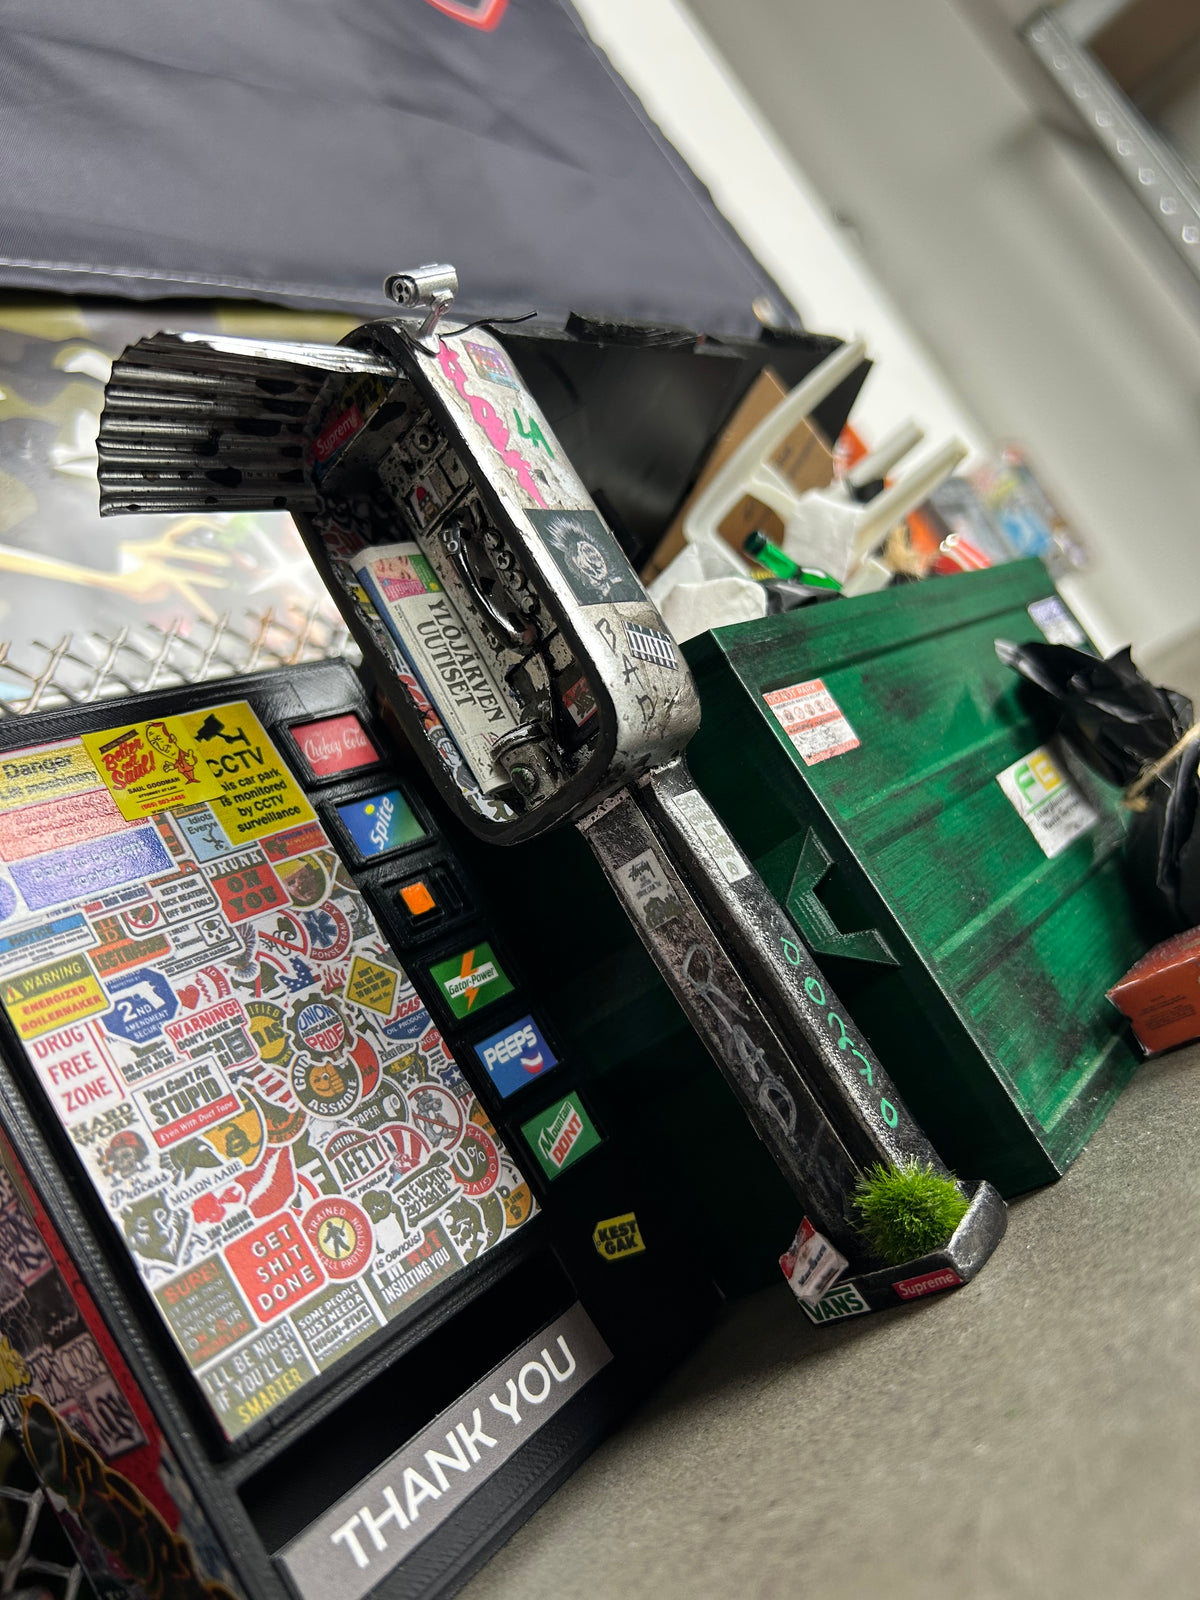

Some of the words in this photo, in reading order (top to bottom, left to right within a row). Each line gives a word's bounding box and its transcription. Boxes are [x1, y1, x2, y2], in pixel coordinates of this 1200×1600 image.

[416, 620, 479, 708] UUTISET
[428, 598, 506, 724] YLÖJÄRVEN
[2, 753, 73, 780] Danger
[101, 737, 144, 773] Better
[111, 750, 157, 791] Saul!
[127, 784, 147, 795] SAUL
[146, 776, 182, 791] GOODMAN
[220, 794, 234, 808] is
[232, 780, 288, 807] monitored
[237, 776, 257, 791] car
[258, 768, 282, 787] park
[236, 804, 302, 834] surveillance
[238, 802, 256, 818] by
[254, 793, 285, 814] CCTV
[369, 796, 395, 851] Spite
[203, 849, 263, 879] DRUNK
[226, 868, 263, 894] ON
[160, 885, 179, 897] KEEP
[180, 878, 199, 891] YOUR
[178, 889, 209, 905] BEATERS
[228, 885, 278, 916] YOU
[166, 907, 181, 919] OFF
[180, 904, 193, 915] MY
[191, 896, 215, 912] TOOLS
[192, 953, 210, 966] YOUR
[208, 944, 231, 958] HANDS
[22, 961, 83, 993] WARNING
[448, 967, 496, 995] Gator-Power
[19, 994, 103, 1033] BOILERMAKER
[22, 984, 88, 1016] ENERGIZED
[299, 1003, 336, 1031] UNION
[124, 1009, 170, 1034] AMENDMENT
[168, 1000, 241, 1041] WARNING!
[176, 1033, 204, 1052] DON'T
[203, 1017, 230, 1037] MAKE
[229, 1013, 246, 1027] ME
[301, 1020, 328, 1039] AMERICAN
[325, 1015, 342, 1029] MADE
[304, 1022, 345, 1052] PRIDE
[386, 1024, 399, 1036] OIL
[32, 1026, 85, 1060] DRUG
[121, 1063, 135, 1075] DO
[134, 1054, 152, 1069] NOT
[152, 1047, 175, 1063] TELL
[483, 1023, 538, 1072] PEEPS
[47, 1049, 98, 1086] FREE
[142, 1085, 166, 1104] You
[165, 1070, 196, 1095] Can't
[194, 1063, 213, 1083] Fix
[61, 1076, 113, 1113] ZONE
[149, 1076, 225, 1126] STUPID
[307, 1077, 358, 1115] ASSHOLE
[69, 1102, 134, 1138] HARD
[73, 1113, 141, 1149] WORK
[158, 1127, 180, 1143] Even
[180, 1118, 199, 1135] With
[198, 1108, 216, 1124] Duct
[215, 1100, 235, 1117] Tape
[352, 1105, 382, 1129] PAPER
[539, 1101, 572, 1154] Mountain
[330, 1132, 359, 1154] THINK
[552, 1112, 583, 1165] DONT
[334, 1138, 385, 1186] AFETY
[109, 1172, 171, 1209] Process
[357, 1171, 389, 1195] PROBLEM
[306, 1205, 348, 1235] TRAINED
[597, 1220, 638, 1243] KEST
[252, 1223, 292, 1259] GET
[339, 1217, 367, 1270] PROTECTION
[375, 1256, 385, 1270] IS
[384, 1231, 422, 1263] OBVIOUS!
[604, 1234, 639, 1256] GAK
[256, 1244, 304, 1284] SHIT
[380, 1254, 434, 1306] INSULTING
[429, 1246, 452, 1270] YOU
[162, 1261, 220, 1305] SURE!
[257, 1265, 317, 1312] DONE
[898, 1271, 955, 1298] Supreme
[181, 1319, 206, 1341] AND
[204, 1301, 237, 1326] WORK
[207, 1308, 243, 1336] YOUR
[297, 1308, 326, 1330] SOME
[323, 1282, 359, 1312] PEOPLE
[303, 1317, 329, 1341] JUST
[326, 1301, 354, 1323] NEED
[353, 1293, 365, 1306] A
[801, 1291, 866, 1322] VANS
[203, 1365, 234, 1396] I'LL
[232, 1348, 255, 1376] BE
[251, 1321, 295, 1362] NICER
[213, 1390, 232, 1414] IF
[233, 1359, 284, 1400] YOU'LL
[281, 1340, 303, 1366] BE
[236, 1366, 304, 1426] SMARTER
[329, 1407, 499, 1569] THANK
[488, 1334, 577, 1426] YOU
